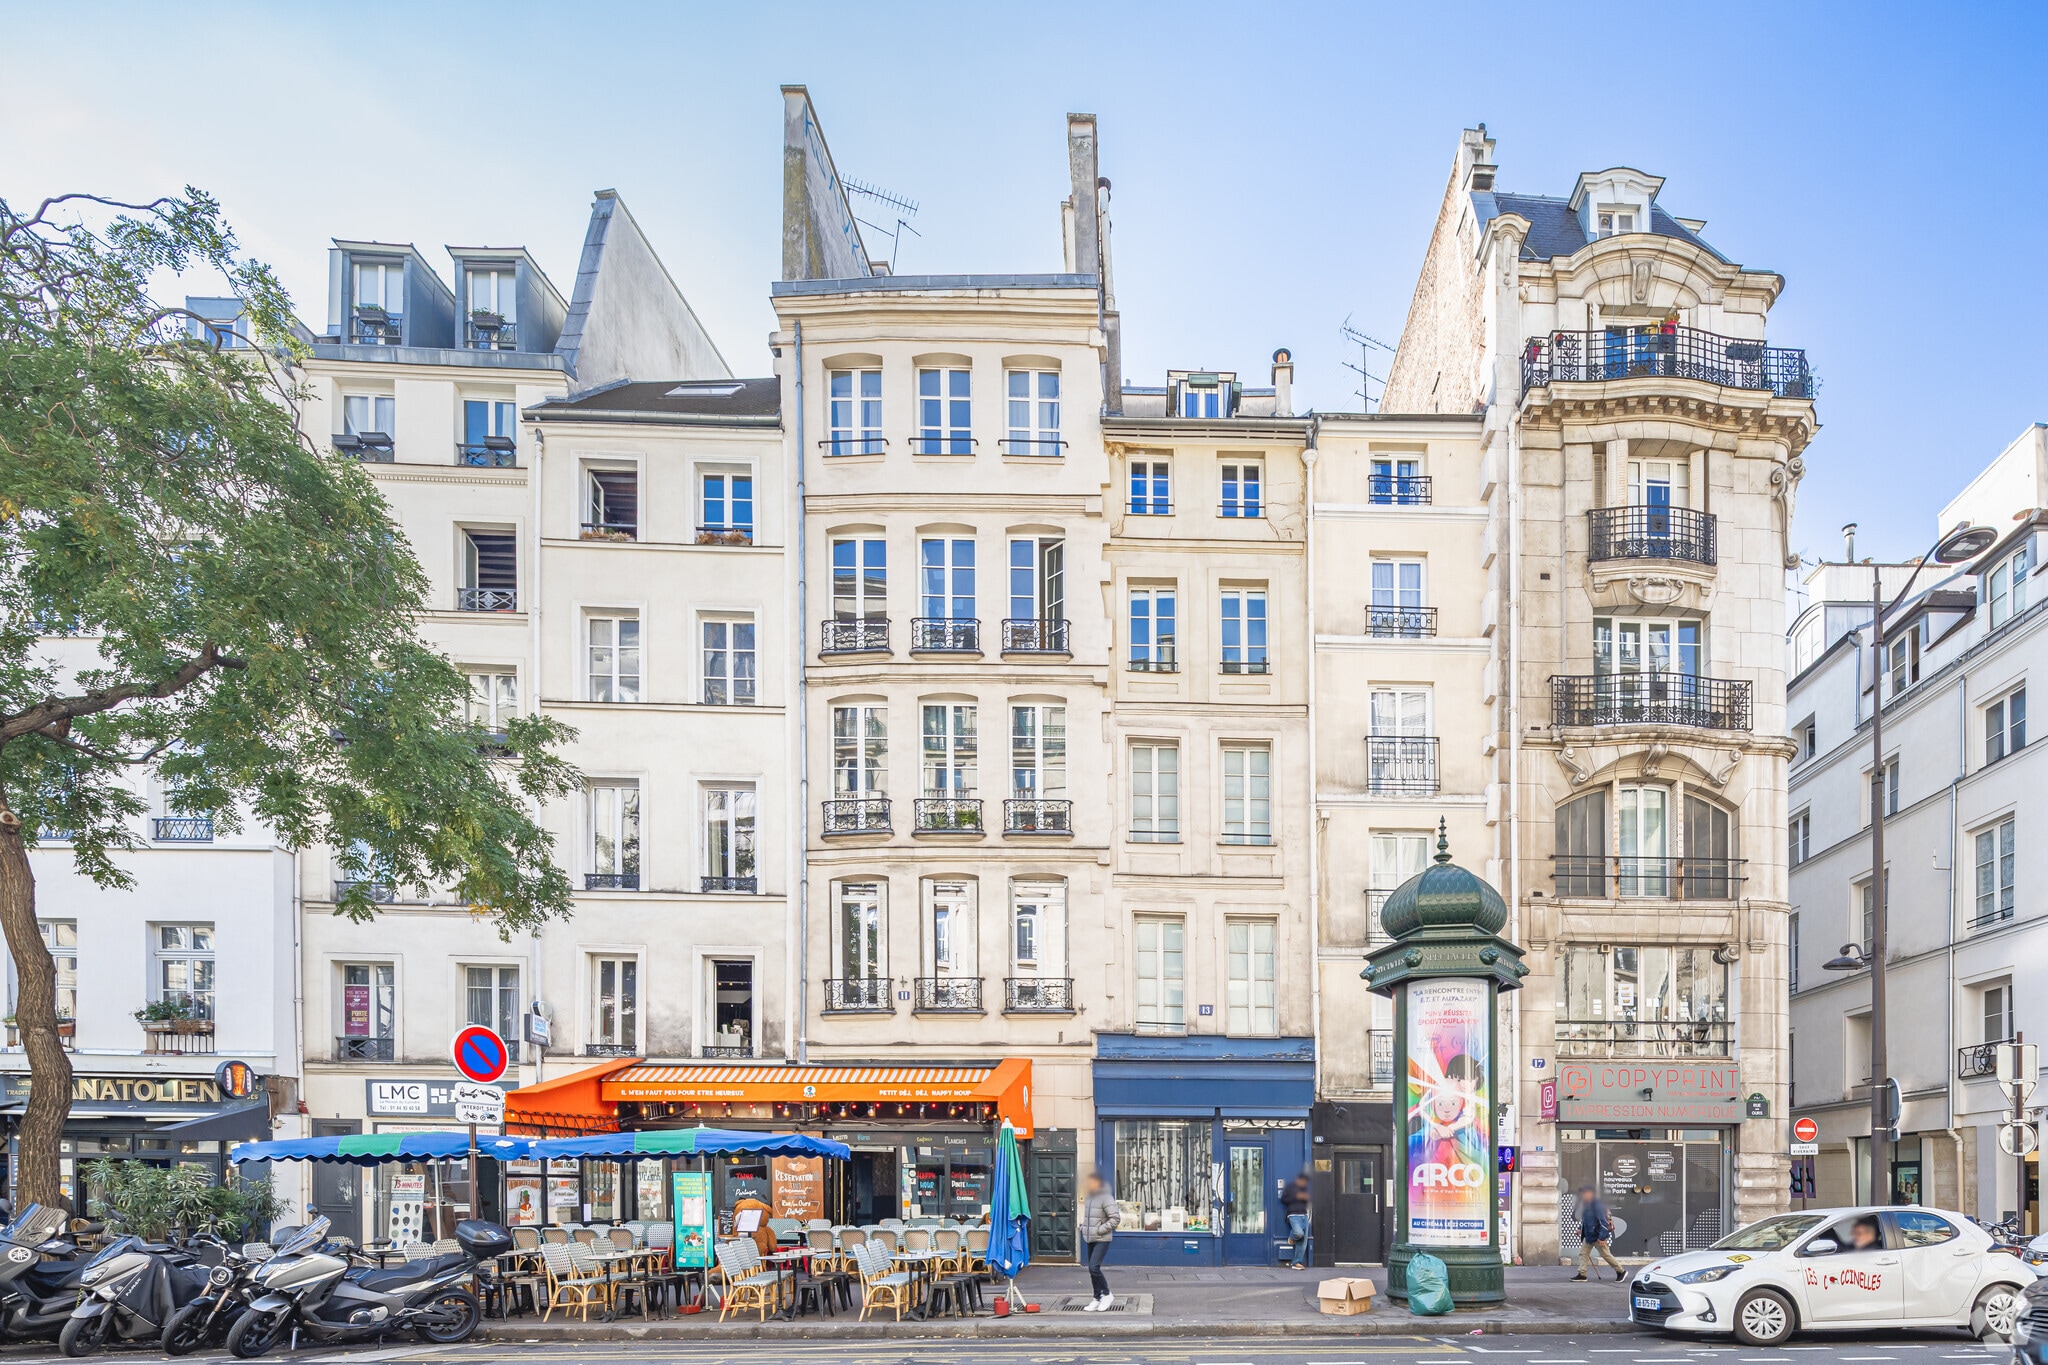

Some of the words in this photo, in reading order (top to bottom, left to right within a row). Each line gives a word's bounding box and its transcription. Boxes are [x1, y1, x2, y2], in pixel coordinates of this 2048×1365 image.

[1424, 951, 1479, 962] SPECTACLES
[900, 991, 908, 1000] 11
[1424, 987, 1465, 995] RENCONTRE
[1202, 1005, 1211, 1015] 13
[1534, 1059, 1543, 1068] 17
[1601, 1068, 1738, 1089] COPYPRINT
[379, 1085, 420, 1100] LMC
[879, 1089, 897, 1097] PETIT
[931, 1089, 952, 1097] HAPPY
[1567, 1105, 1653, 1118] IMPRESSION
[1412, 1162, 1485, 1188] ARCO
[1804, 1267, 1818, 1286] LES
